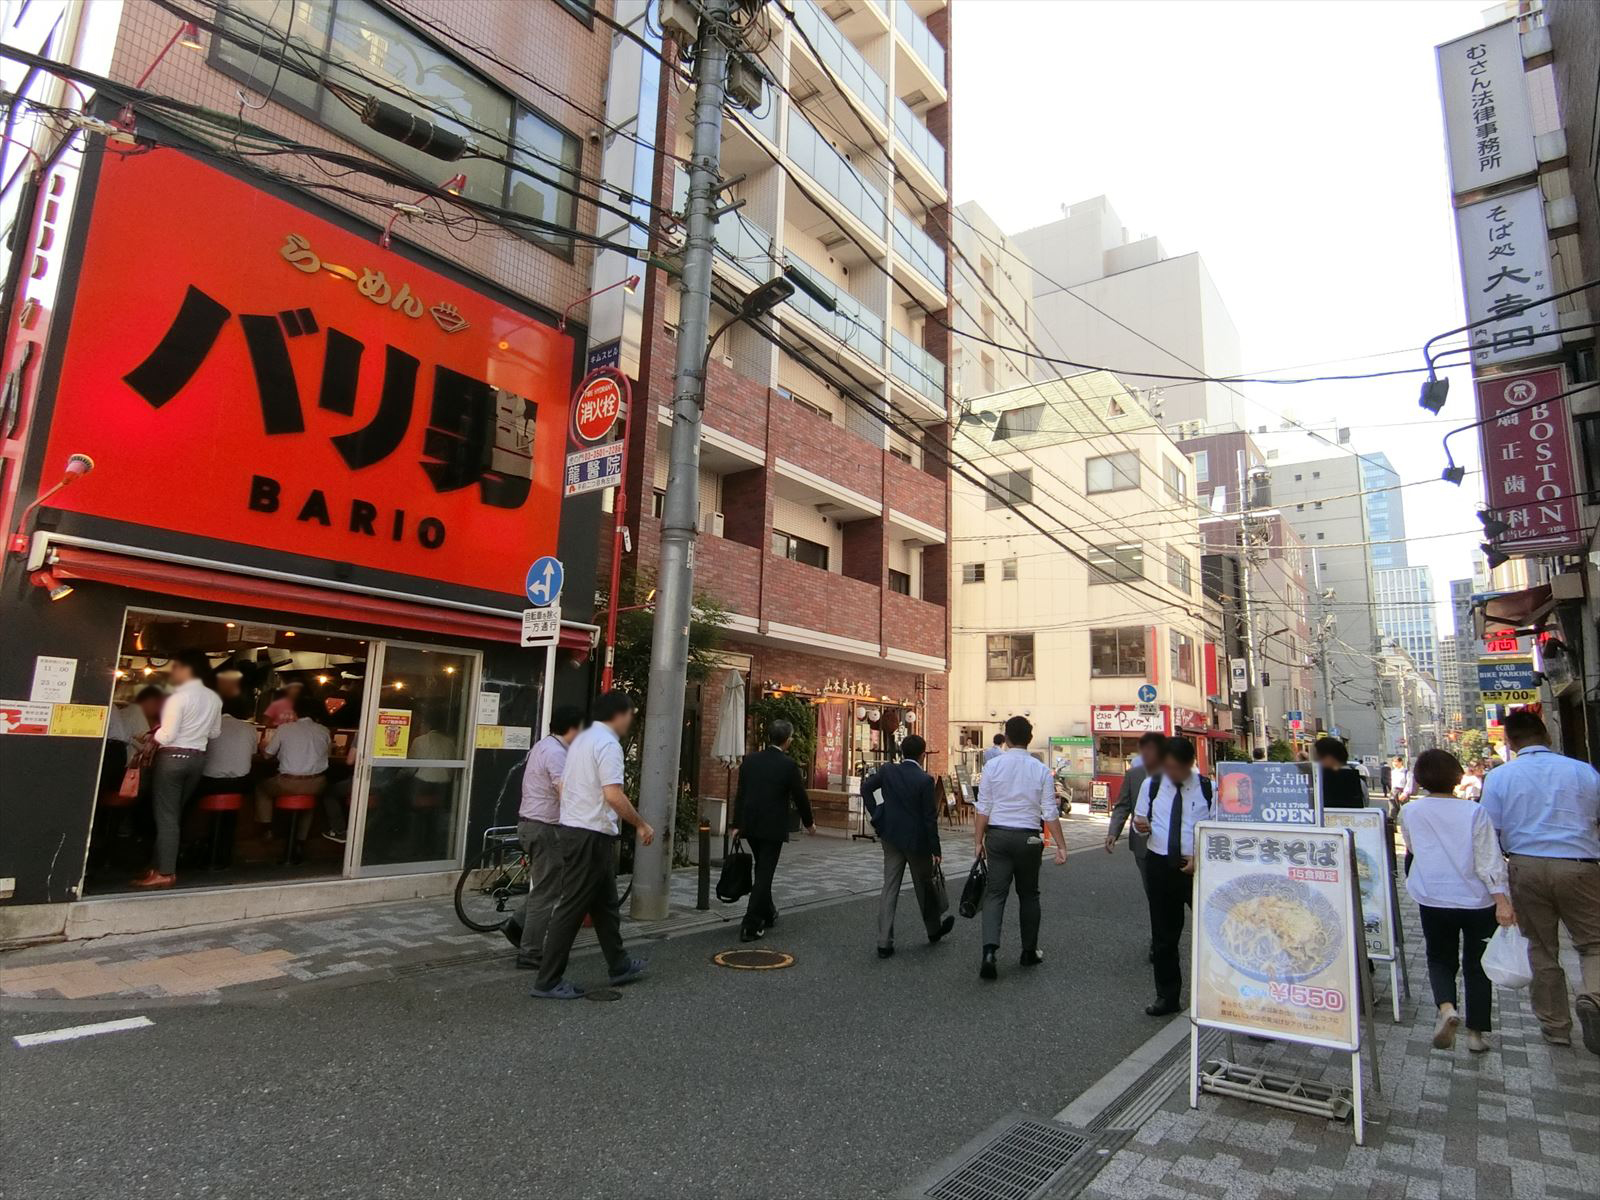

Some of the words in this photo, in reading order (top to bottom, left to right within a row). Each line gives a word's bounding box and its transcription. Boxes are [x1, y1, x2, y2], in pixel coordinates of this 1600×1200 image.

[1466, 43, 1501, 172] むさん法律事務所
[1486, 205, 1515, 261] そば処
[280, 233, 424, 318] らーめん
[1483, 266, 1535, 353] 大吉田
[122, 284, 538, 510] バリ男
[581, 393, 616, 425] 消火栓
[1529, 403, 1564, 525] BOSTON
[249, 475, 446, 549] BARIO
[524, 621, 557, 632] 一方通行
[1267, 772, 1309, 786] 大吉田
[1262, 808, 1315, 824] OPEN
[1206, 834, 1338, 868] 黒ごまそば
[1290, 869, 1336, 882] 15食限定
[1269, 981, 1344, 1012] ¥550
